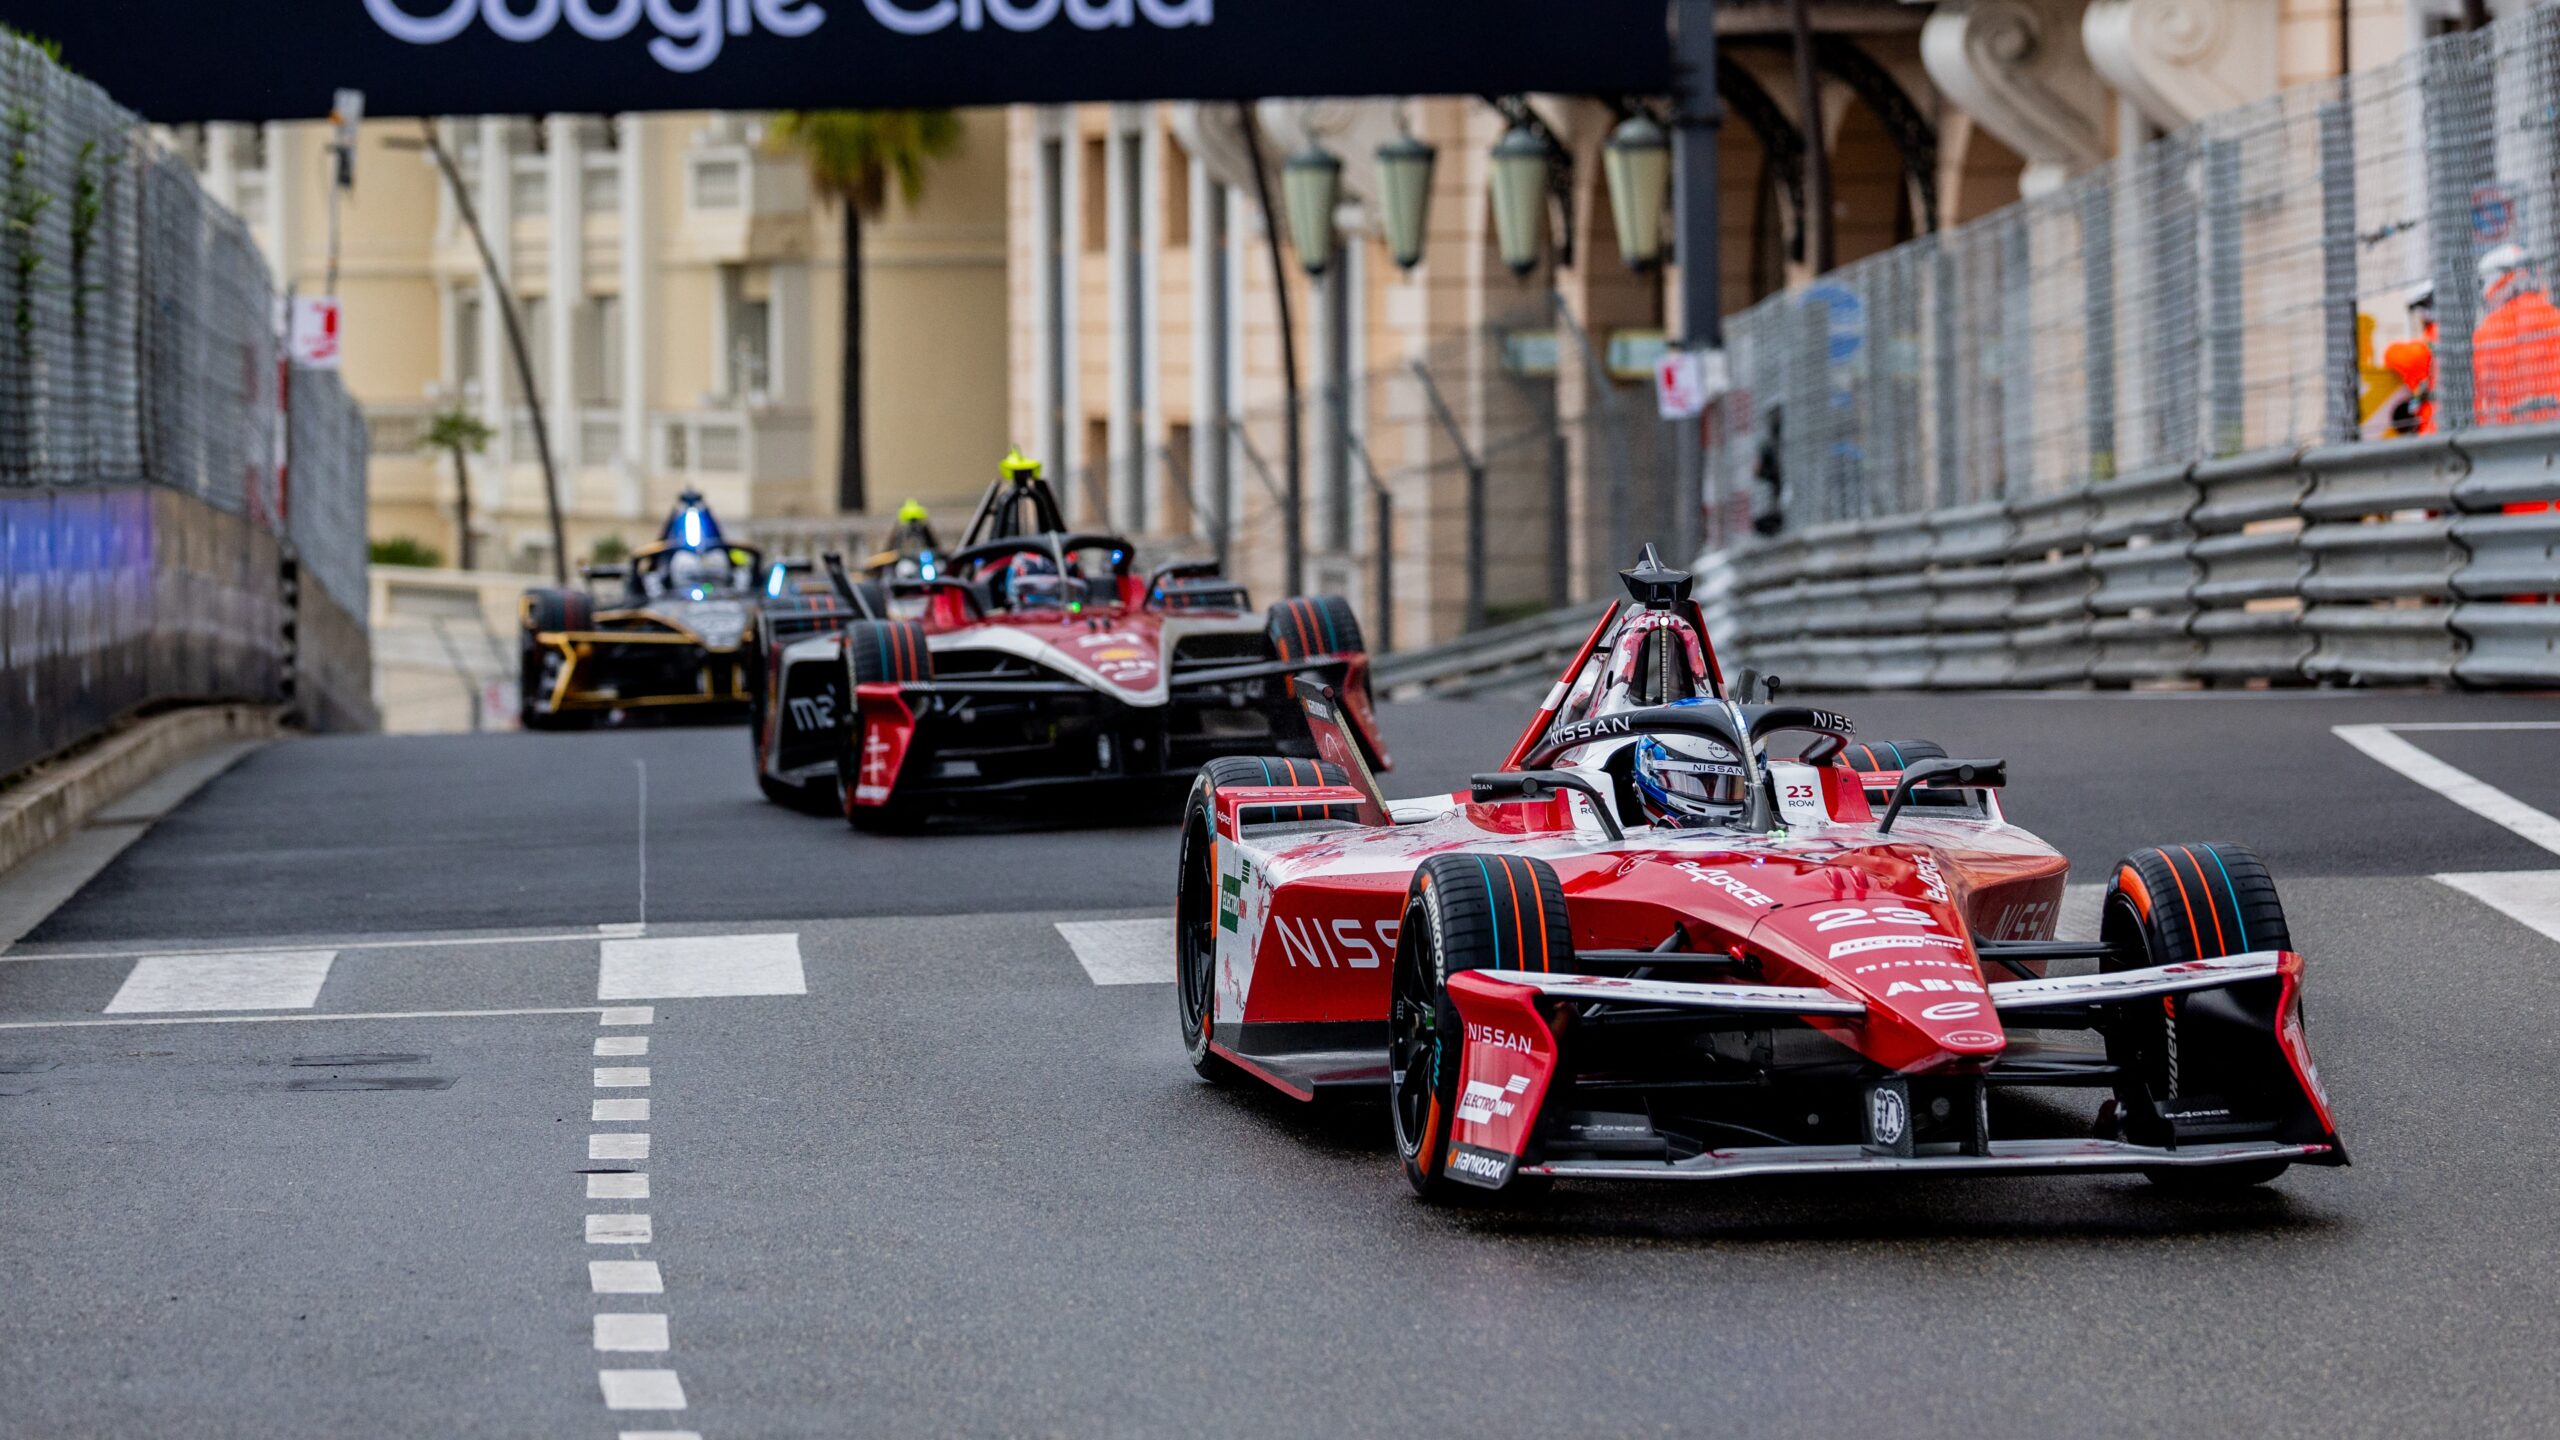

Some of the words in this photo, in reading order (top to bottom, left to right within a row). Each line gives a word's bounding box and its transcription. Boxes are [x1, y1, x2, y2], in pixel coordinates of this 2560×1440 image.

[1550, 715, 1630, 746] NISSAN
[1813, 711, 1856, 734] NISS
[1693, 764, 1743, 775] NISSAN
[1786, 785, 1813, 798] 23
[1788, 799, 1815, 808] ROW
[1808, 906, 1939, 932] 23
[1273, 915, 1402, 969] NISS
[1855, 960, 1973, 974] nismo
[1886, 978, 1985, 997] ABB
[1468, 1022, 1532, 1055] NISSAN
[1874, 1095, 1901, 1137] FIA
